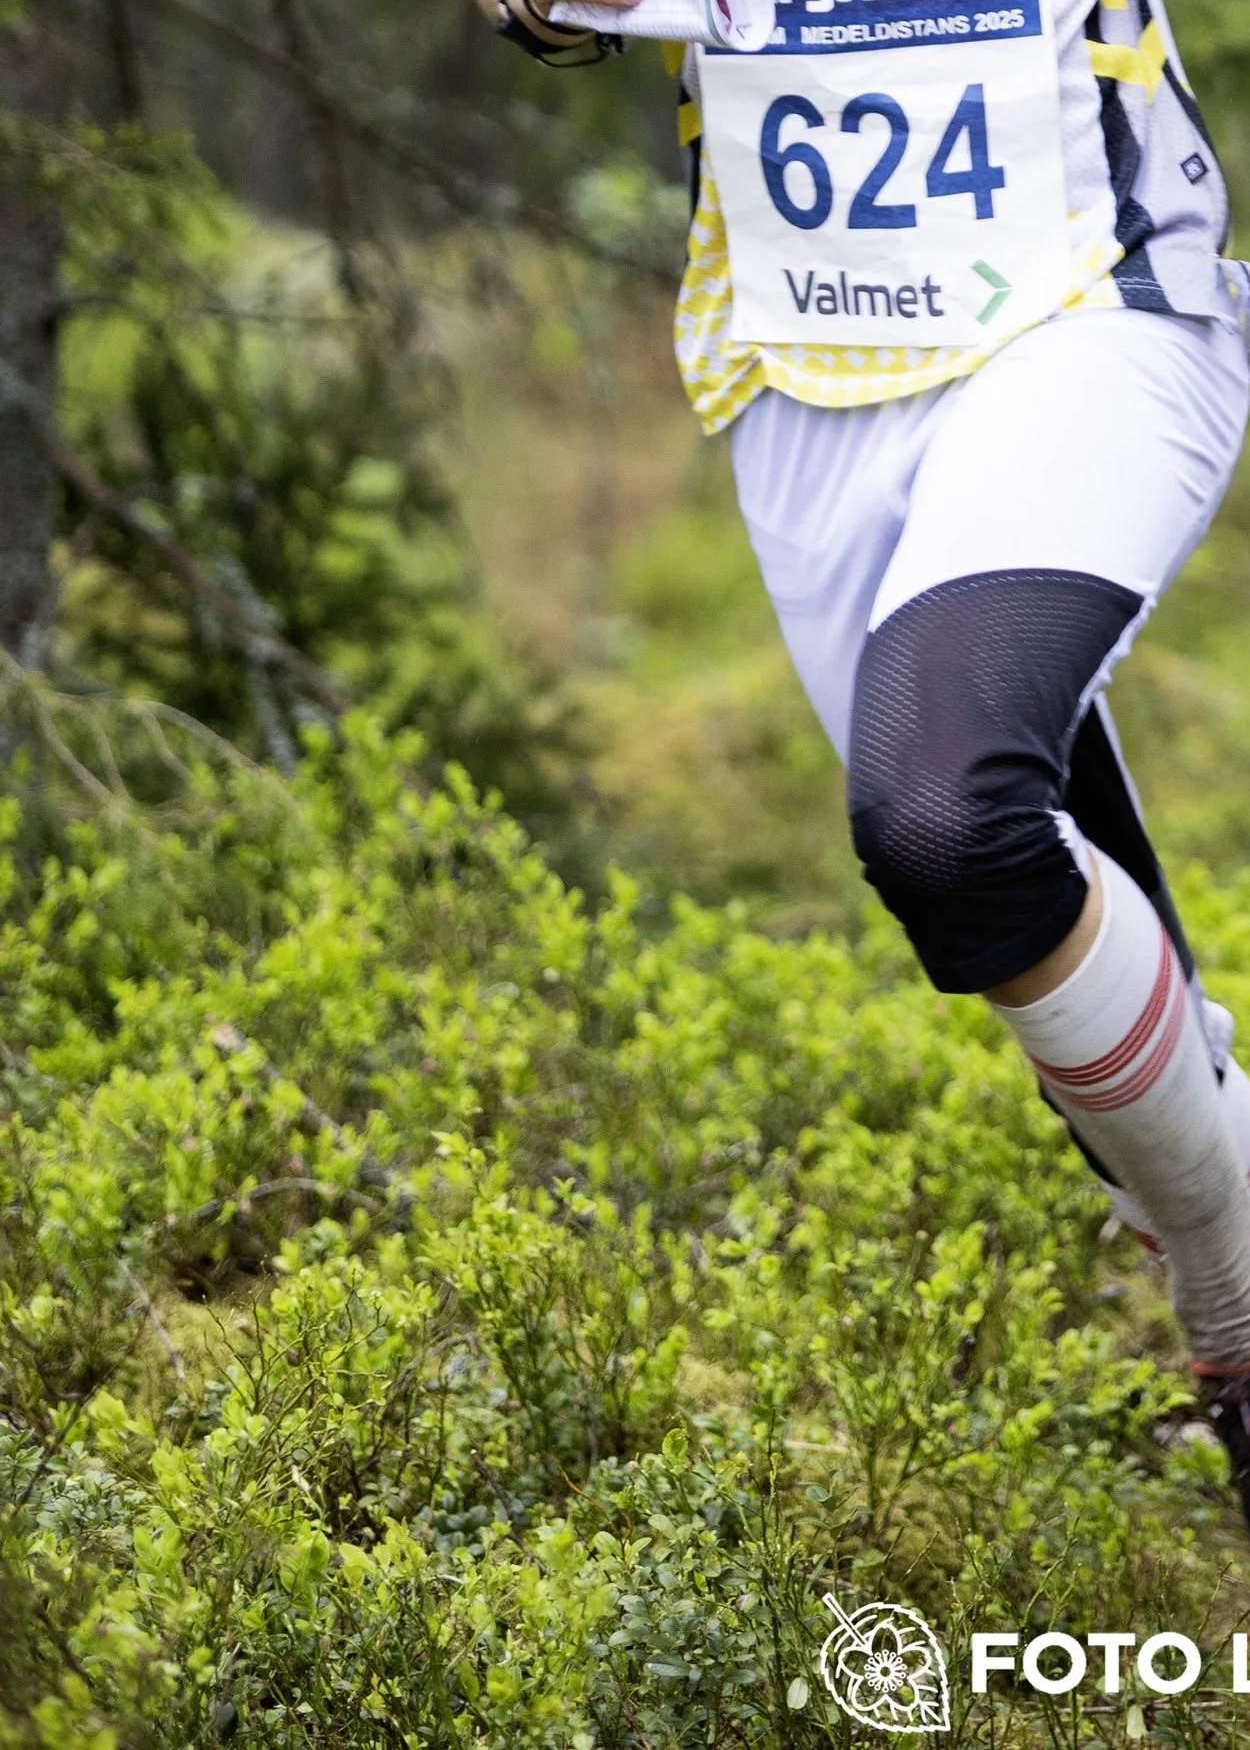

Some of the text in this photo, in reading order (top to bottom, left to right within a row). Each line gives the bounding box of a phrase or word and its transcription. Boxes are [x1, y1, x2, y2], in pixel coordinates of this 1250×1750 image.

[800, 14, 971, 46] MEDELDISTANS
[973, 8, 1026, 33] 2025
[759, 82, 1006, 230] 624
[783, 268, 944, 318] Valmet
